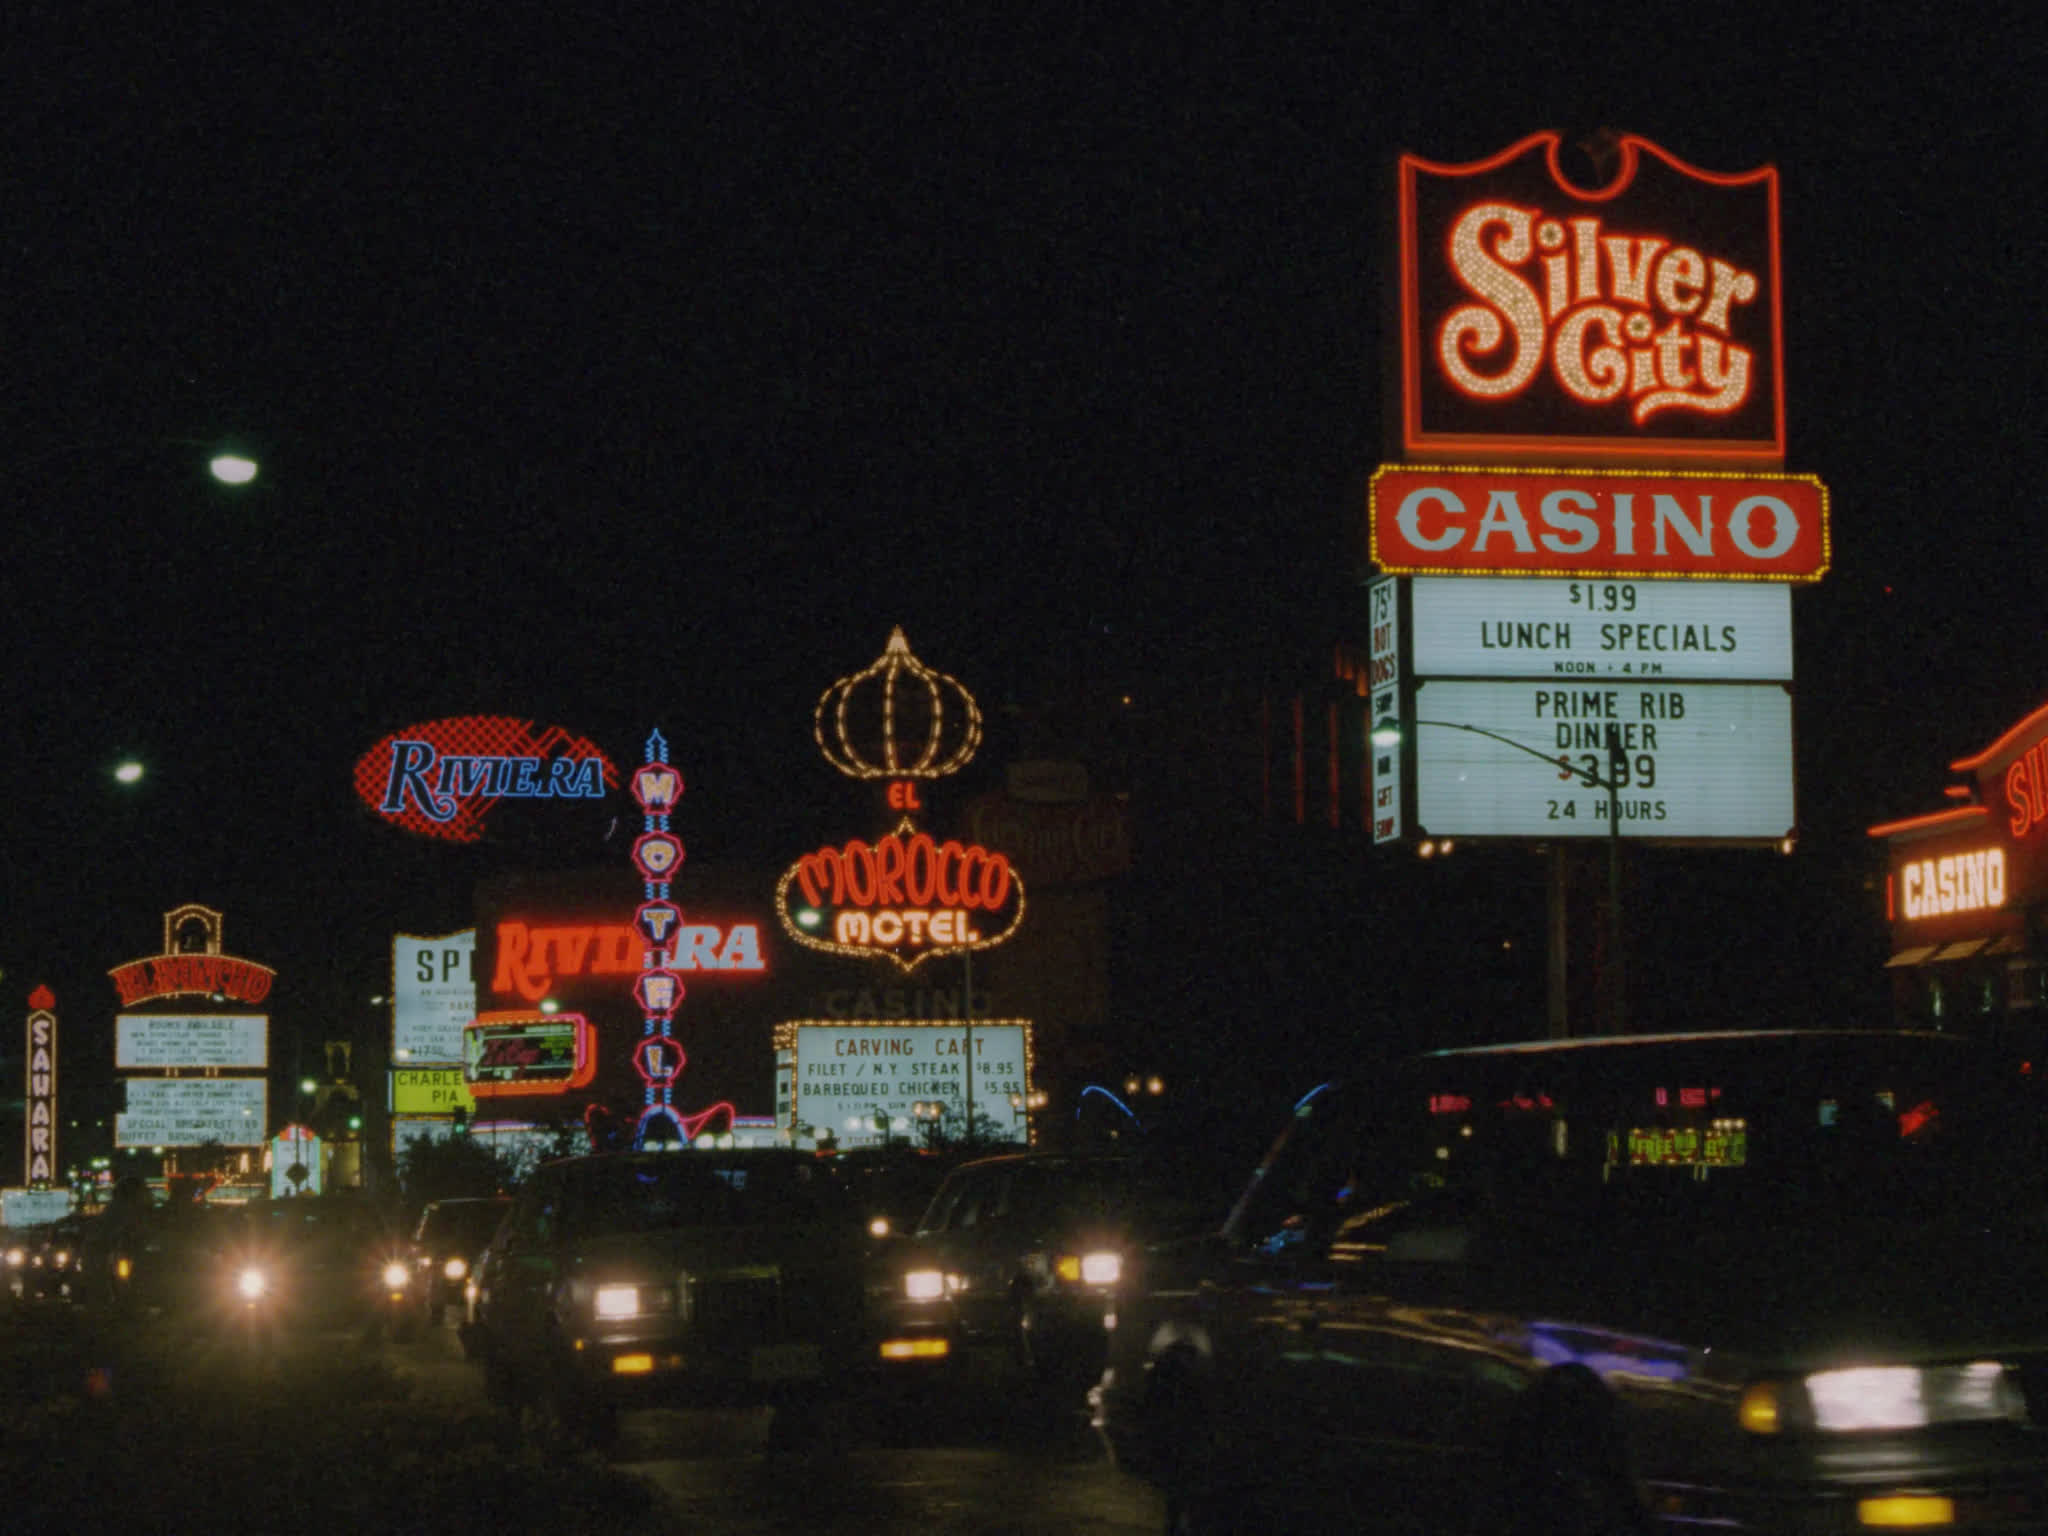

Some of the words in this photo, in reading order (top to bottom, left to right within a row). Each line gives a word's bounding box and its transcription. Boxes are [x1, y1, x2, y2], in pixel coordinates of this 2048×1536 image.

[1439, 202, 1758, 400] Silver
[1552, 305, 1751, 425] City
[1396, 487, 1800, 559] CASINO
[1569, 583, 1637, 612] $1.99
[1480, 621, 1571, 650] LUNCH
[1600, 624, 1737, 652] SPECIALS
[1553, 661, 1596, 674] NOON
[1623, 662, 1632, 674] 4
[1641, 662, 1663, 674] PM
[1536, 691, 1618, 719] PRIME
[1641, 692, 1685, 719] RIB
[380, 739, 607, 823] RIVIERA
[888, 781, 921, 811] EL
[1547, 800, 1576, 819] 24
[1595, 800, 1667, 820] HOURS
[797, 833, 1011, 911] MOROCCO
[1902, 848, 2006, 920] CASINO
[642, 773, 677, 1078] MOTEL
[836, 909, 980, 946] MOTEL
[835, 1038, 914, 1057] CARVING
[808, 1063, 847, 1077] FILET
[911, 1062, 960, 1076] STEAK
[31, 1019, 51, 1180] SAHARA
[802, 1082, 889, 1096] BARBEQUED
[897, 1081, 960, 1097] CHICKEN
